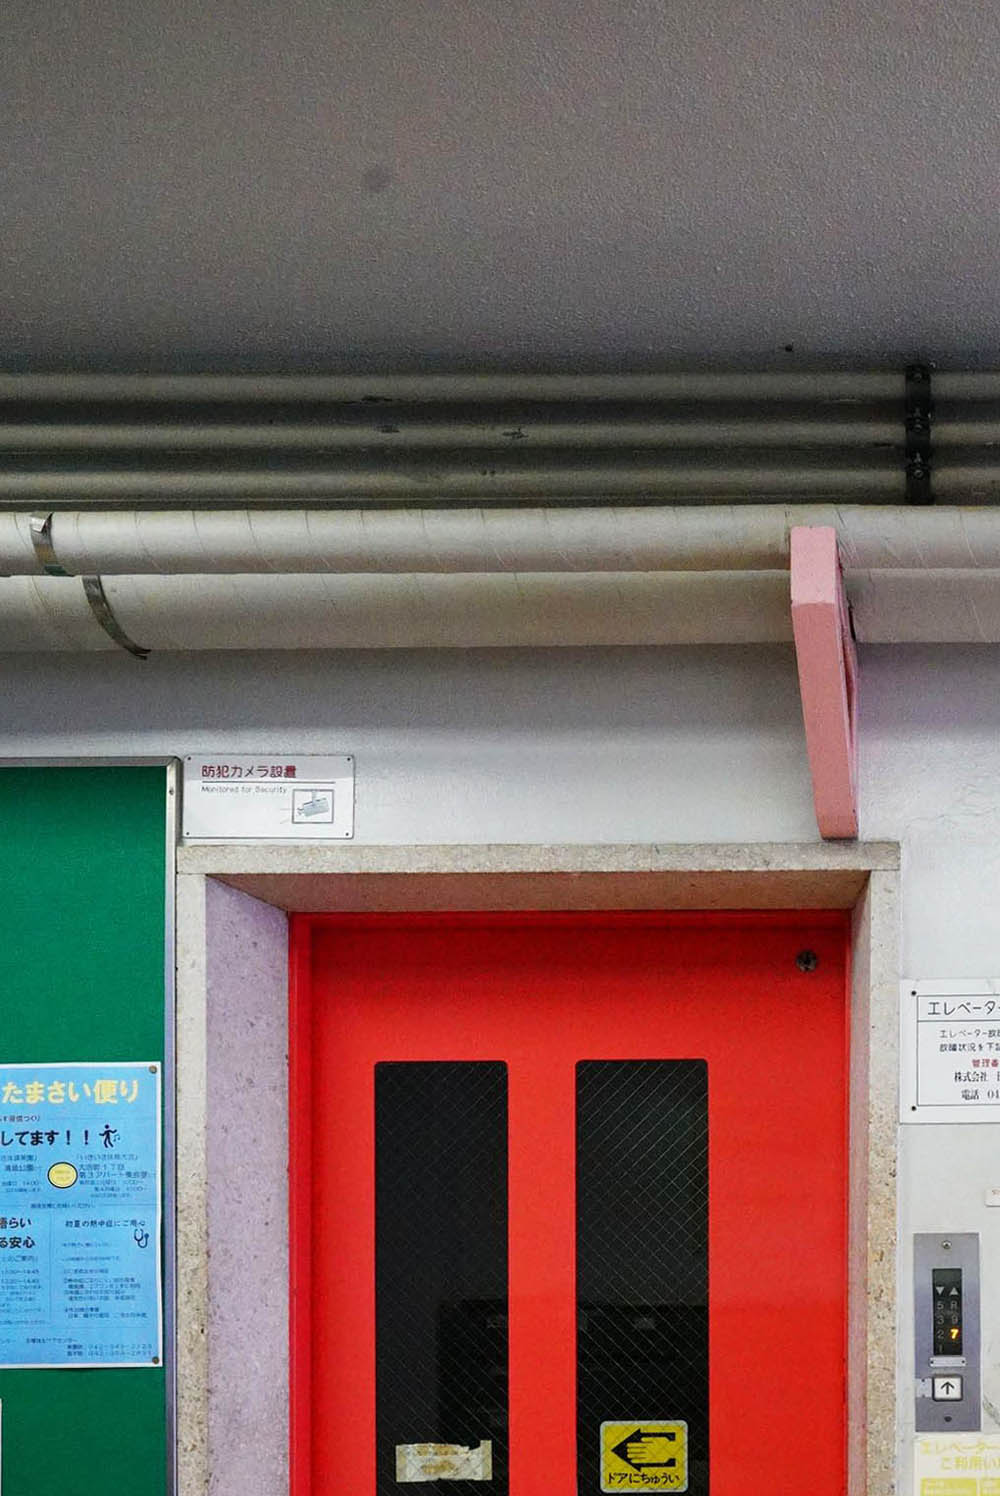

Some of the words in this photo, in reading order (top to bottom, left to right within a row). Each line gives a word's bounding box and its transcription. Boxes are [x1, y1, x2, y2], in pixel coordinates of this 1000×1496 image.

[201, 765, 297, 778] 防犯カメラ設置
[201, 785, 239, 793] Monitored
[954, 1071, 989, 1082] 株式会社
[2, 1079, 139, 1104] たまさい便り
[961, 1089, 980, 1101] 電話
[950, 1328, 960, 1339] 7
[607, 1473, 680, 1484] ドアにちゅうい
